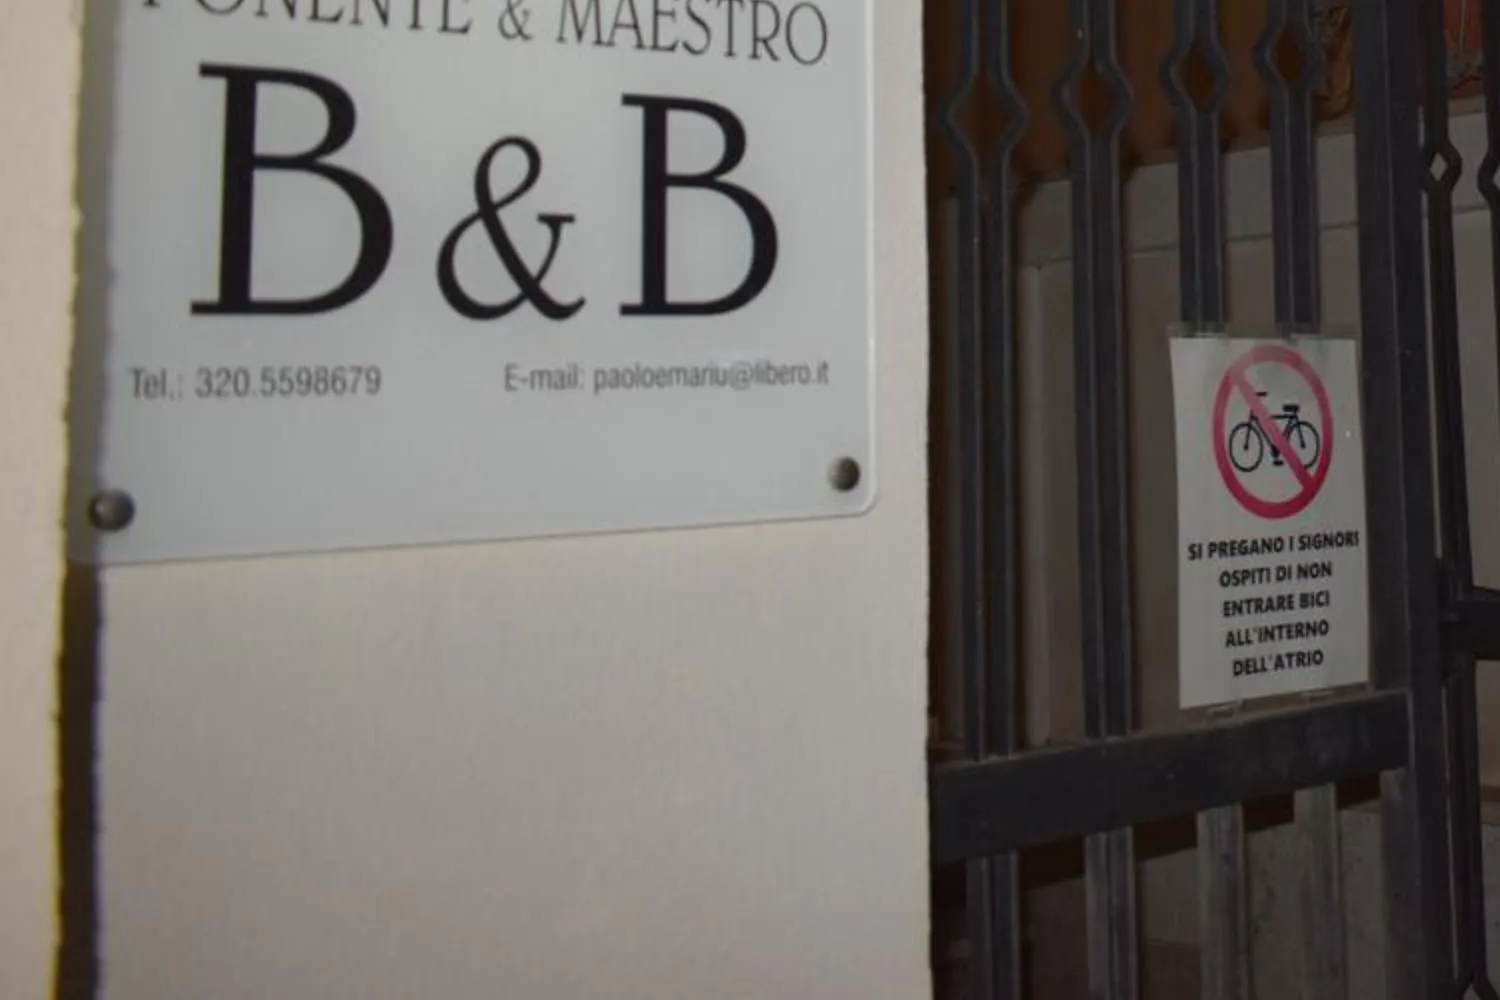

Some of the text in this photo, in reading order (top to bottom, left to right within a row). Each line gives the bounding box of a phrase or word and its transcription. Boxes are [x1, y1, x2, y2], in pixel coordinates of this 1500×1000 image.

[190, 61, 779, 321] B & B
[195, 363, 383, 399] 320.5598679
[504, 362, 584, 392] E-mail:
[1187, 530, 1360, 561] SI PREGANO I SIGNORI
[1219, 561, 1332, 588] OSPITI DI NON
[1222, 590, 1330, 618] ENTRARE BICI
[1225, 619, 1330, 649] ALL'INTERNO
[1232, 648, 1324, 677] DELL'ATRIO
